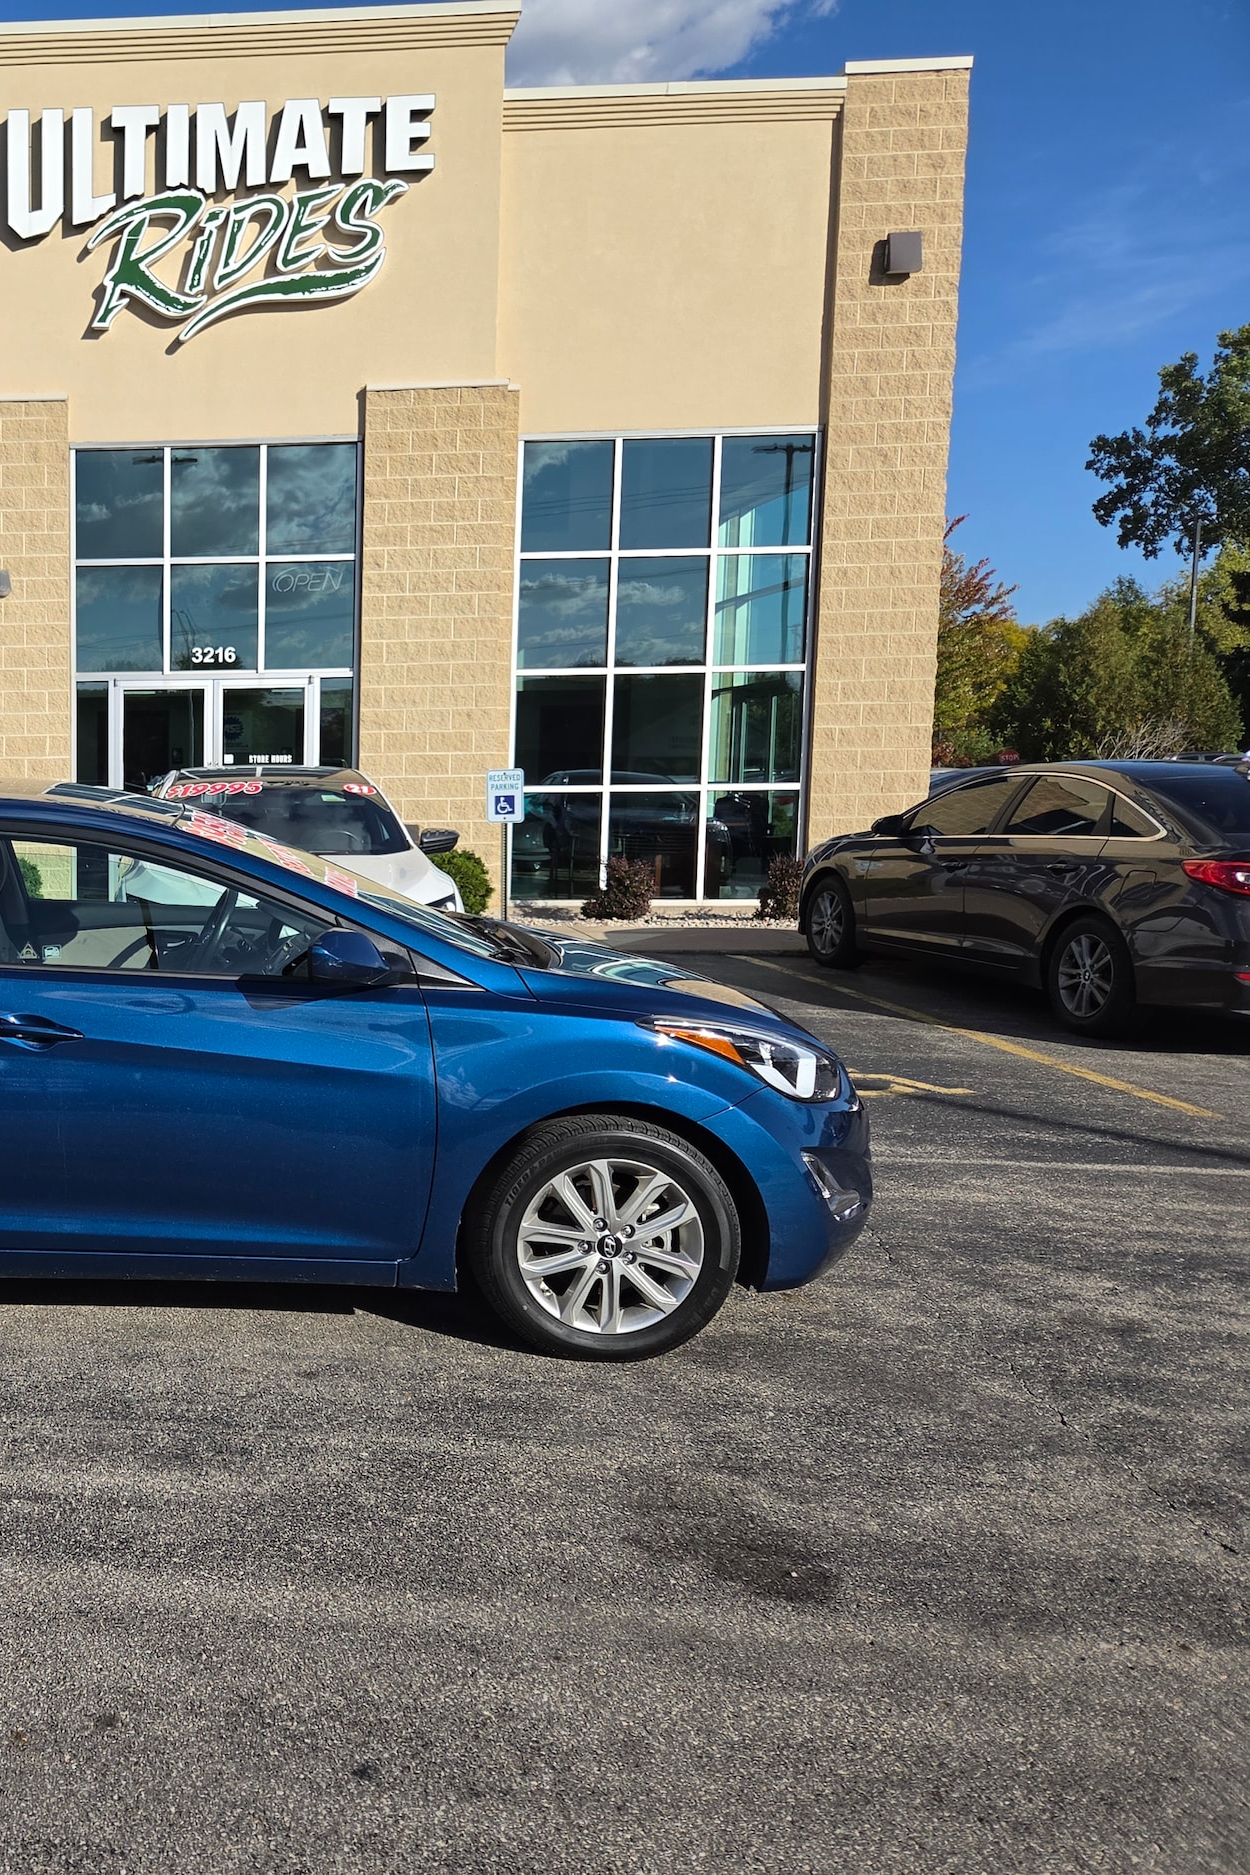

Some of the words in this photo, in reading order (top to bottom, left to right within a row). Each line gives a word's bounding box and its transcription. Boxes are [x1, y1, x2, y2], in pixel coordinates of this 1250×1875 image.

[6, 93, 436, 240] ULTIMATE
[276, 572, 343, 592] OPEN
[191, 646, 236, 663] 3216
[248, 754, 270, 763] STORE
[271, 754, 293, 763] HOURS
[489, 774, 521, 782] RESERVED
[165, 781, 263, 799] $19995
[349, 784, 369, 794] 21
[490, 783, 519, 791] PARKING
